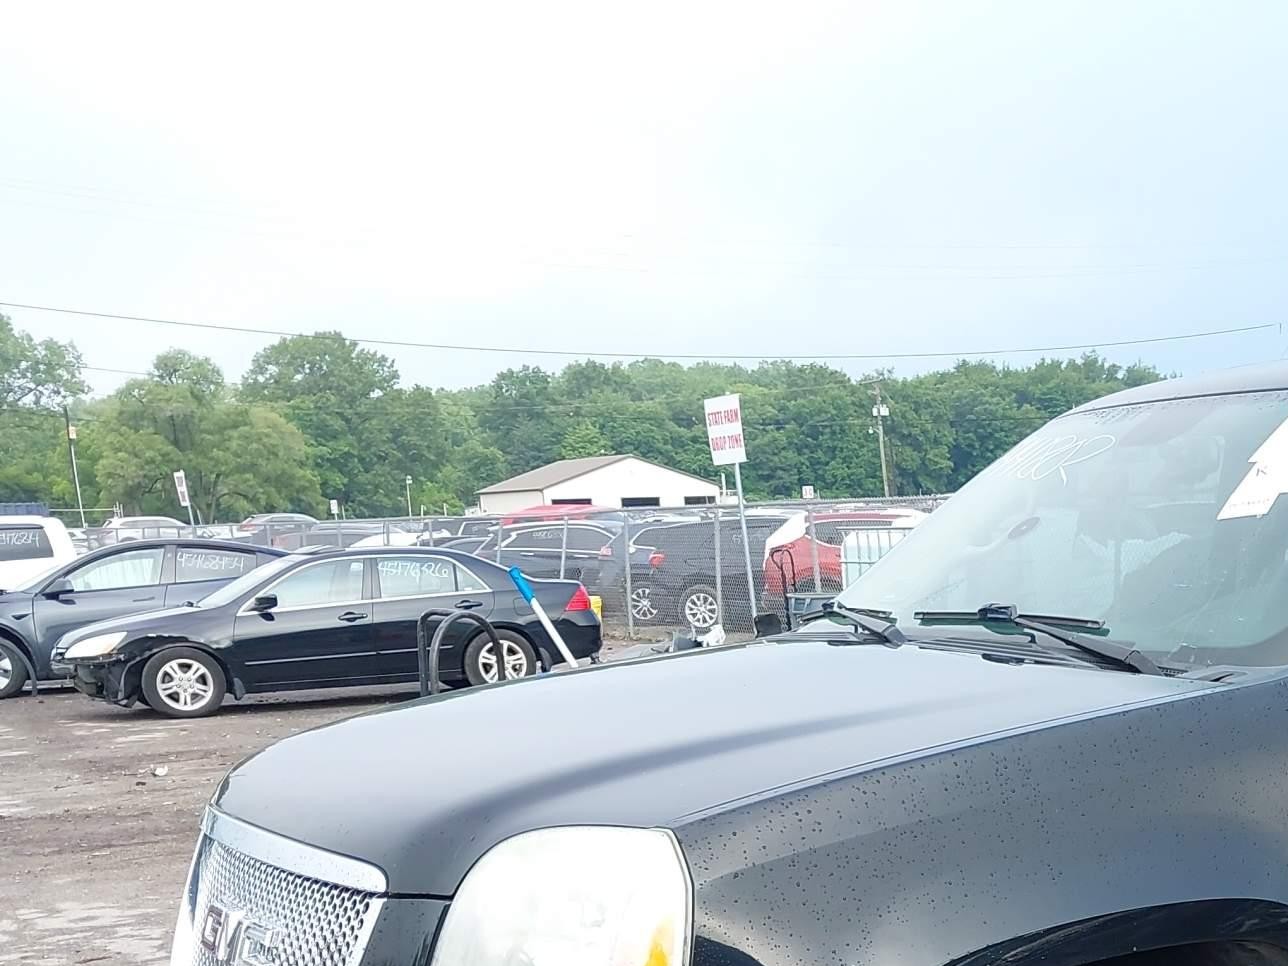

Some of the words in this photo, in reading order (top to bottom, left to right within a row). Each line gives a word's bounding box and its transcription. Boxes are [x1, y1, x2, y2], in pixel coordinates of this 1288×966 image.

[707, 411, 724, 427] STATE
[723, 408, 739, 425] FARM
[711, 436, 728, 452] DROP
[728, 433, 743, 449] ZONE
